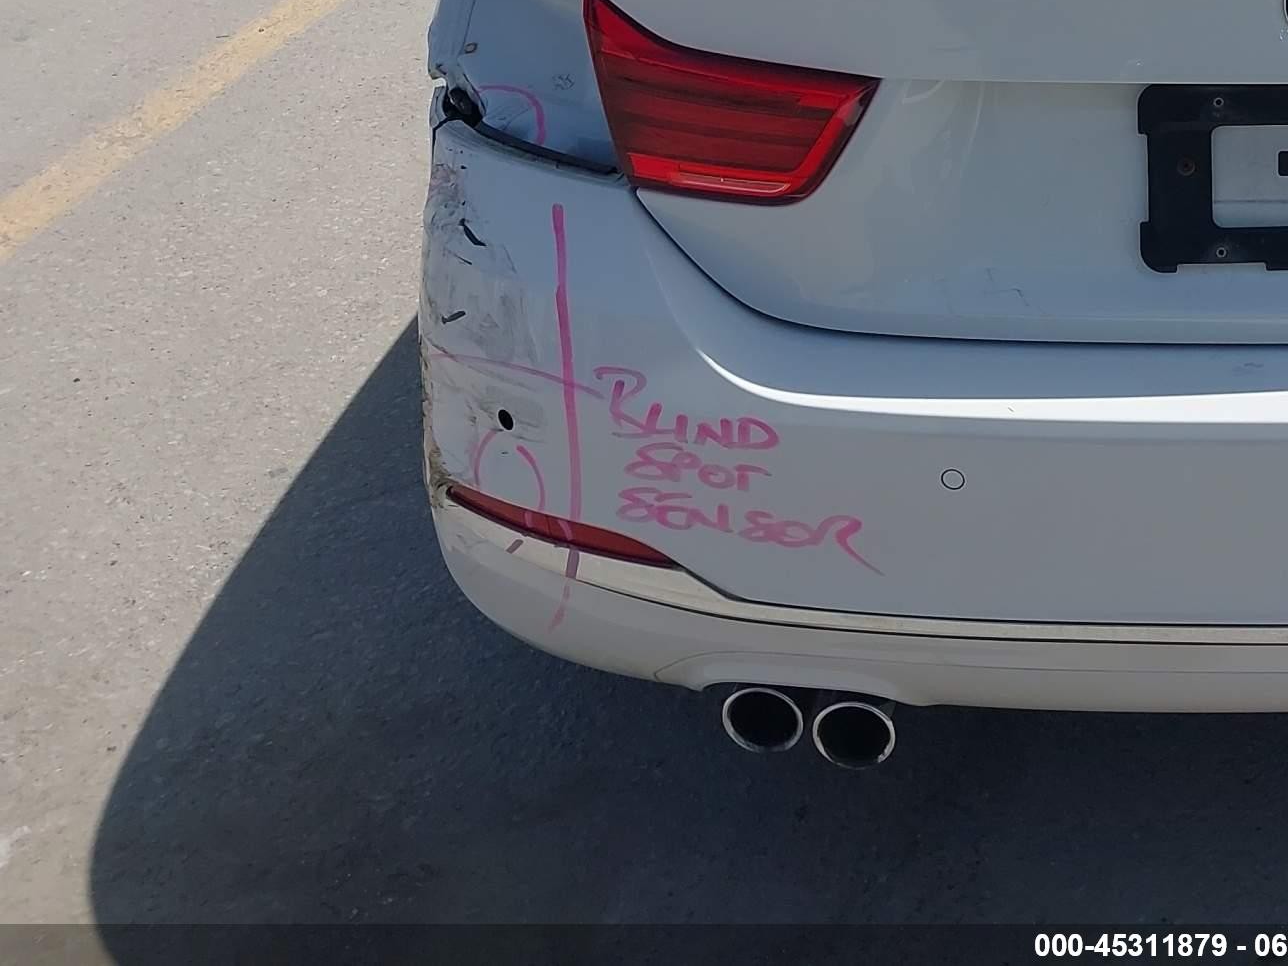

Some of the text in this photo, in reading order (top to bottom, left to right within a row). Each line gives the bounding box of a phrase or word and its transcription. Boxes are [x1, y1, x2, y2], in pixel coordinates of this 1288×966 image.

[593, 366, 780, 450] BLIND
[624, 442, 772, 491] SPOT
[616, 487, 885, 577] SENSOR
